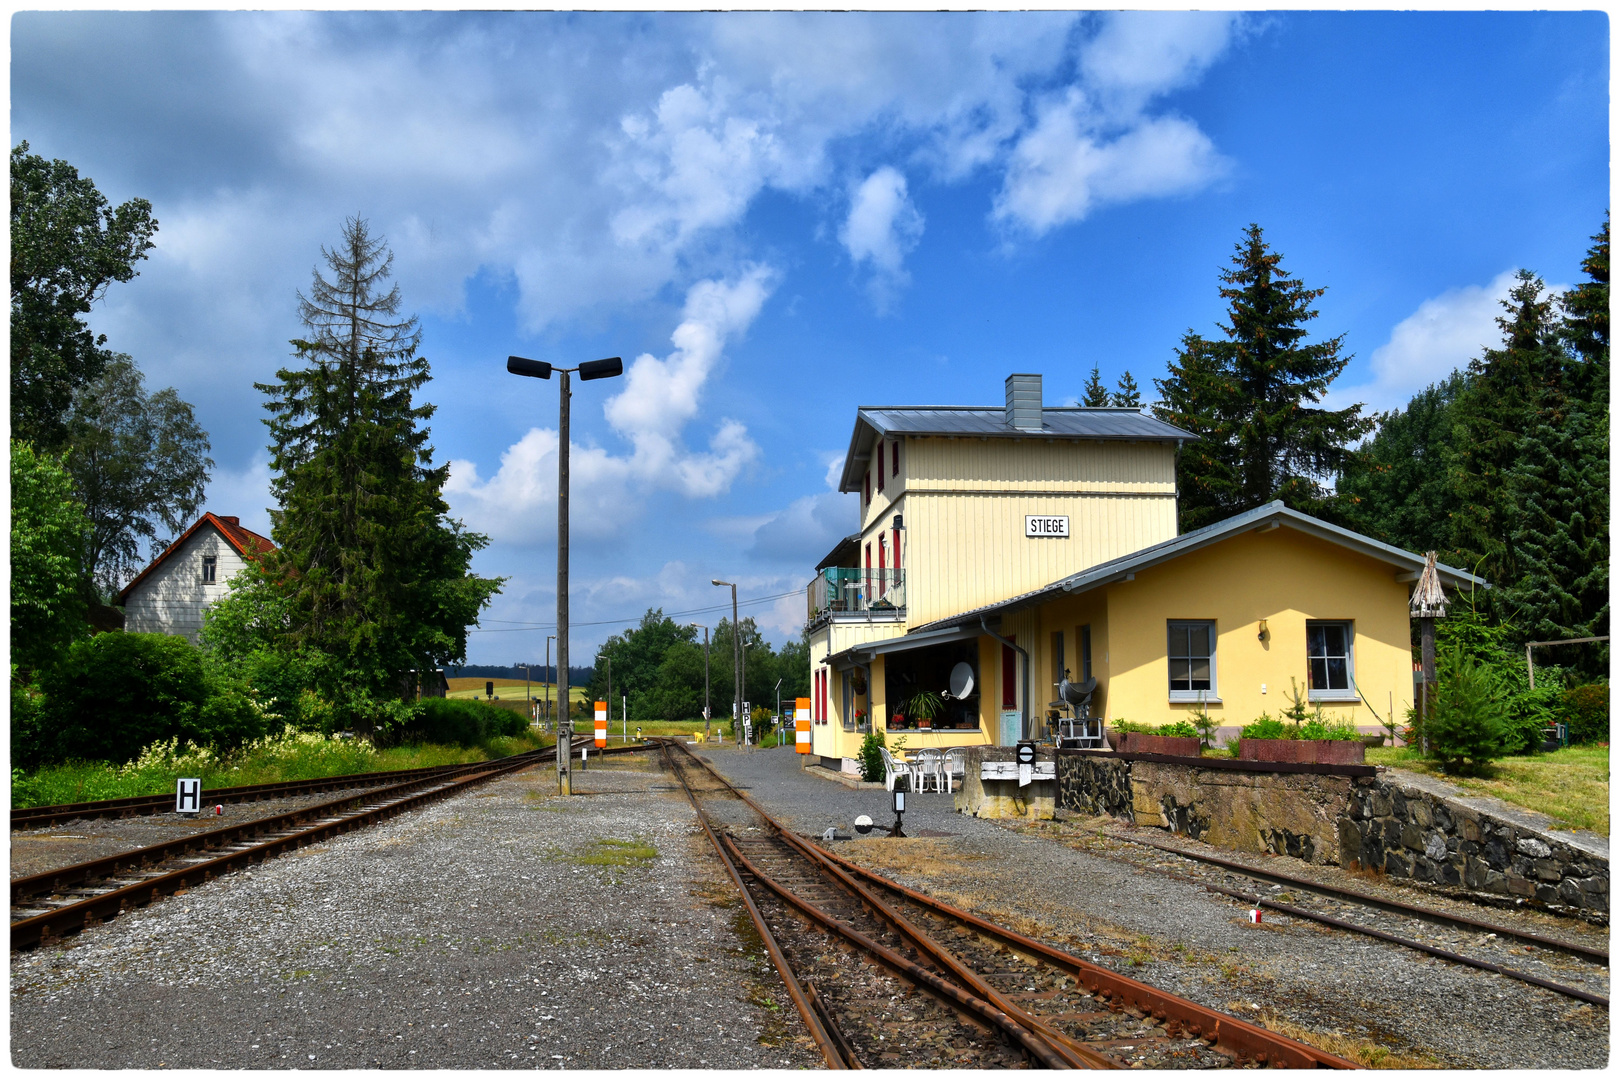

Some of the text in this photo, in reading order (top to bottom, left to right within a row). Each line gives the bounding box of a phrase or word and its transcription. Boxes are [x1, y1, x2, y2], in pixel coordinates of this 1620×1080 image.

[1031, 519, 1064, 532] STIEGE
[742, 703, 750, 713] H
[744, 715, 750, 724] P
[179, 781, 198, 810] H
